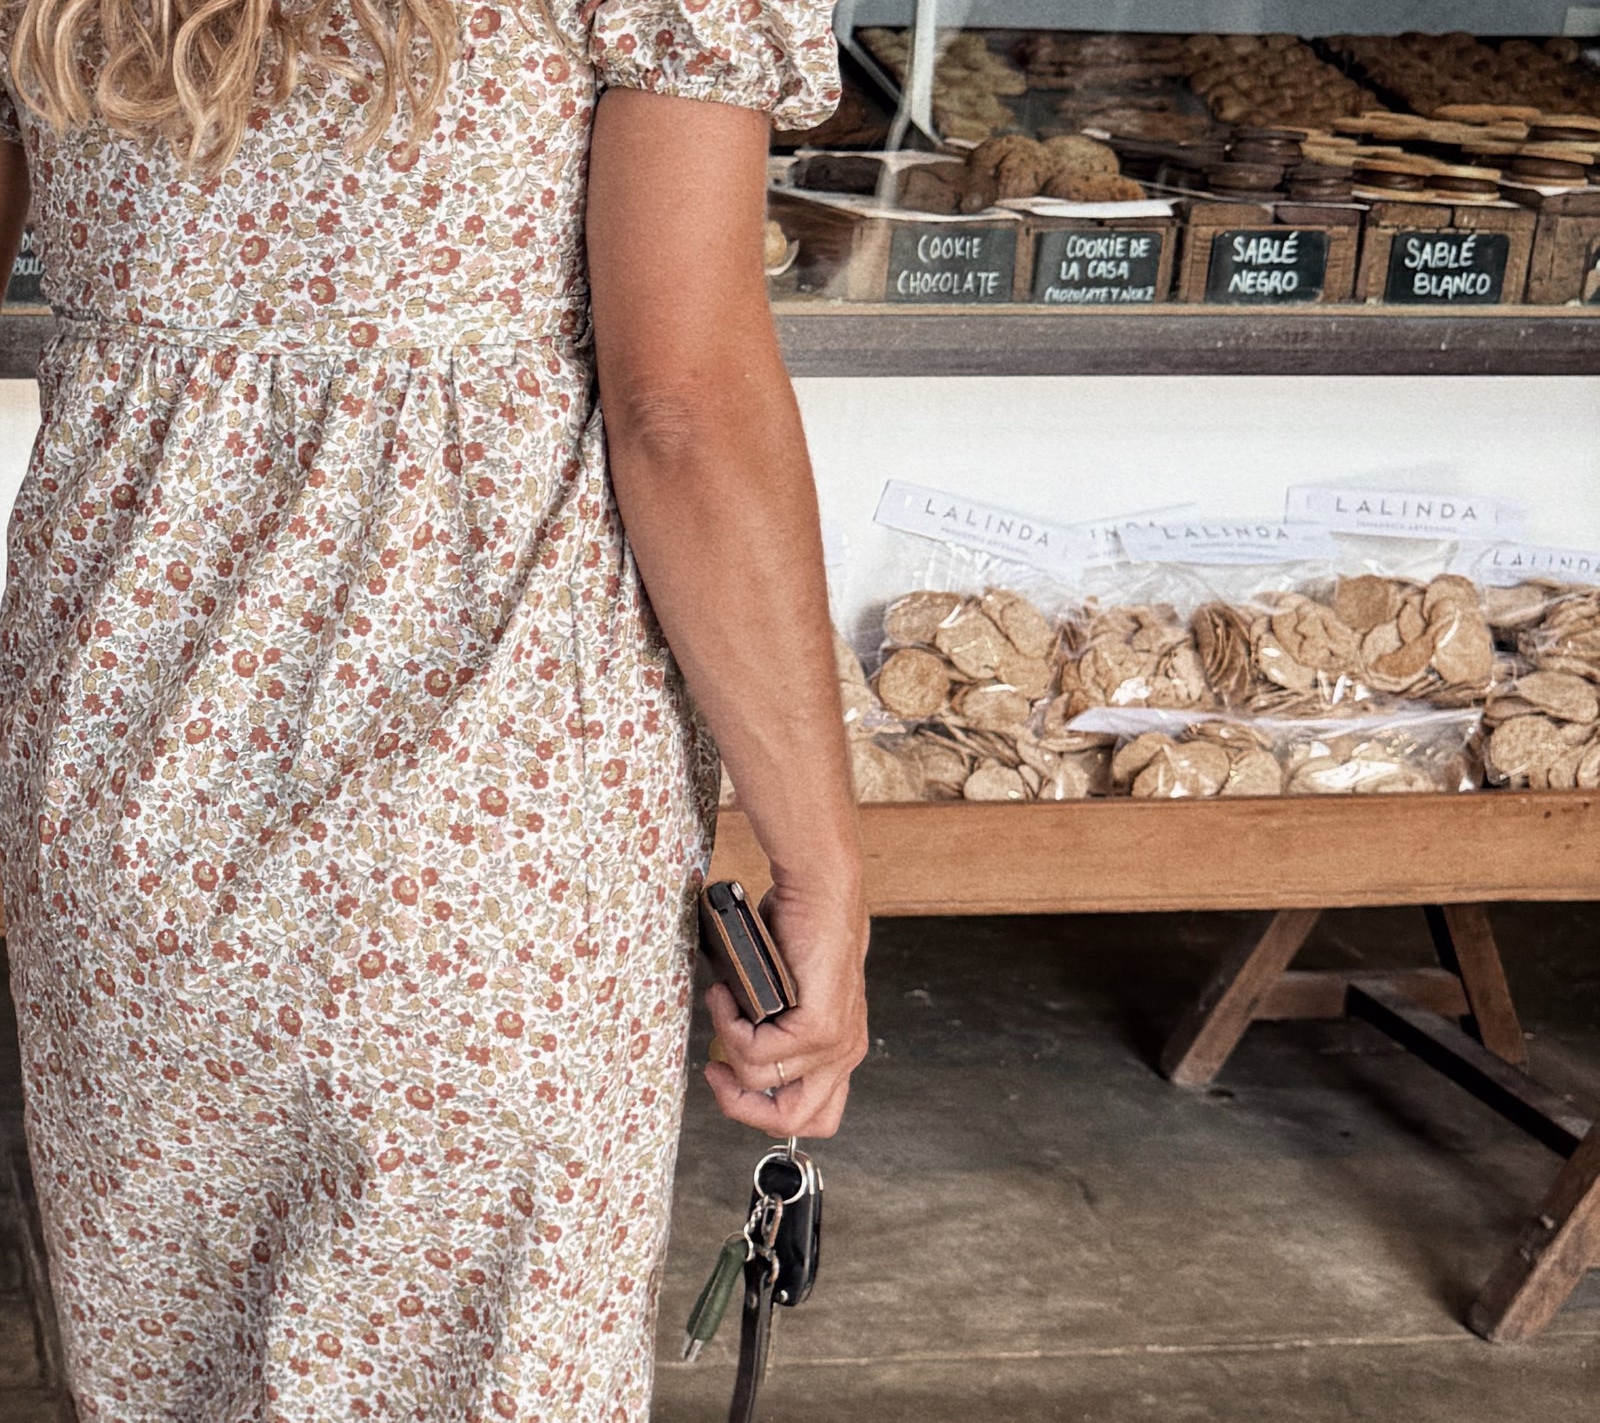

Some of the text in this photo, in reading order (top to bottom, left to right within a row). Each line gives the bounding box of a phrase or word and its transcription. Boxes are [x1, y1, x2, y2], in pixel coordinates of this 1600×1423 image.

[1129, 238, 1151, 258] DE
[1232, 231, 1298, 265] SABLÉ
[1404, 234, 1477, 269] SABLÉ
[897, 270, 999, 296] CHOCOLATE
[1060, 260, 1129, 281] LA CASA
[1228, 270, 1298, 295] NEGRO
[1413, 272, 1491, 300] BLANCO
[925, 497, 1049, 546] LALINDA
[1336, 497, 1477, 520] LALINDA
